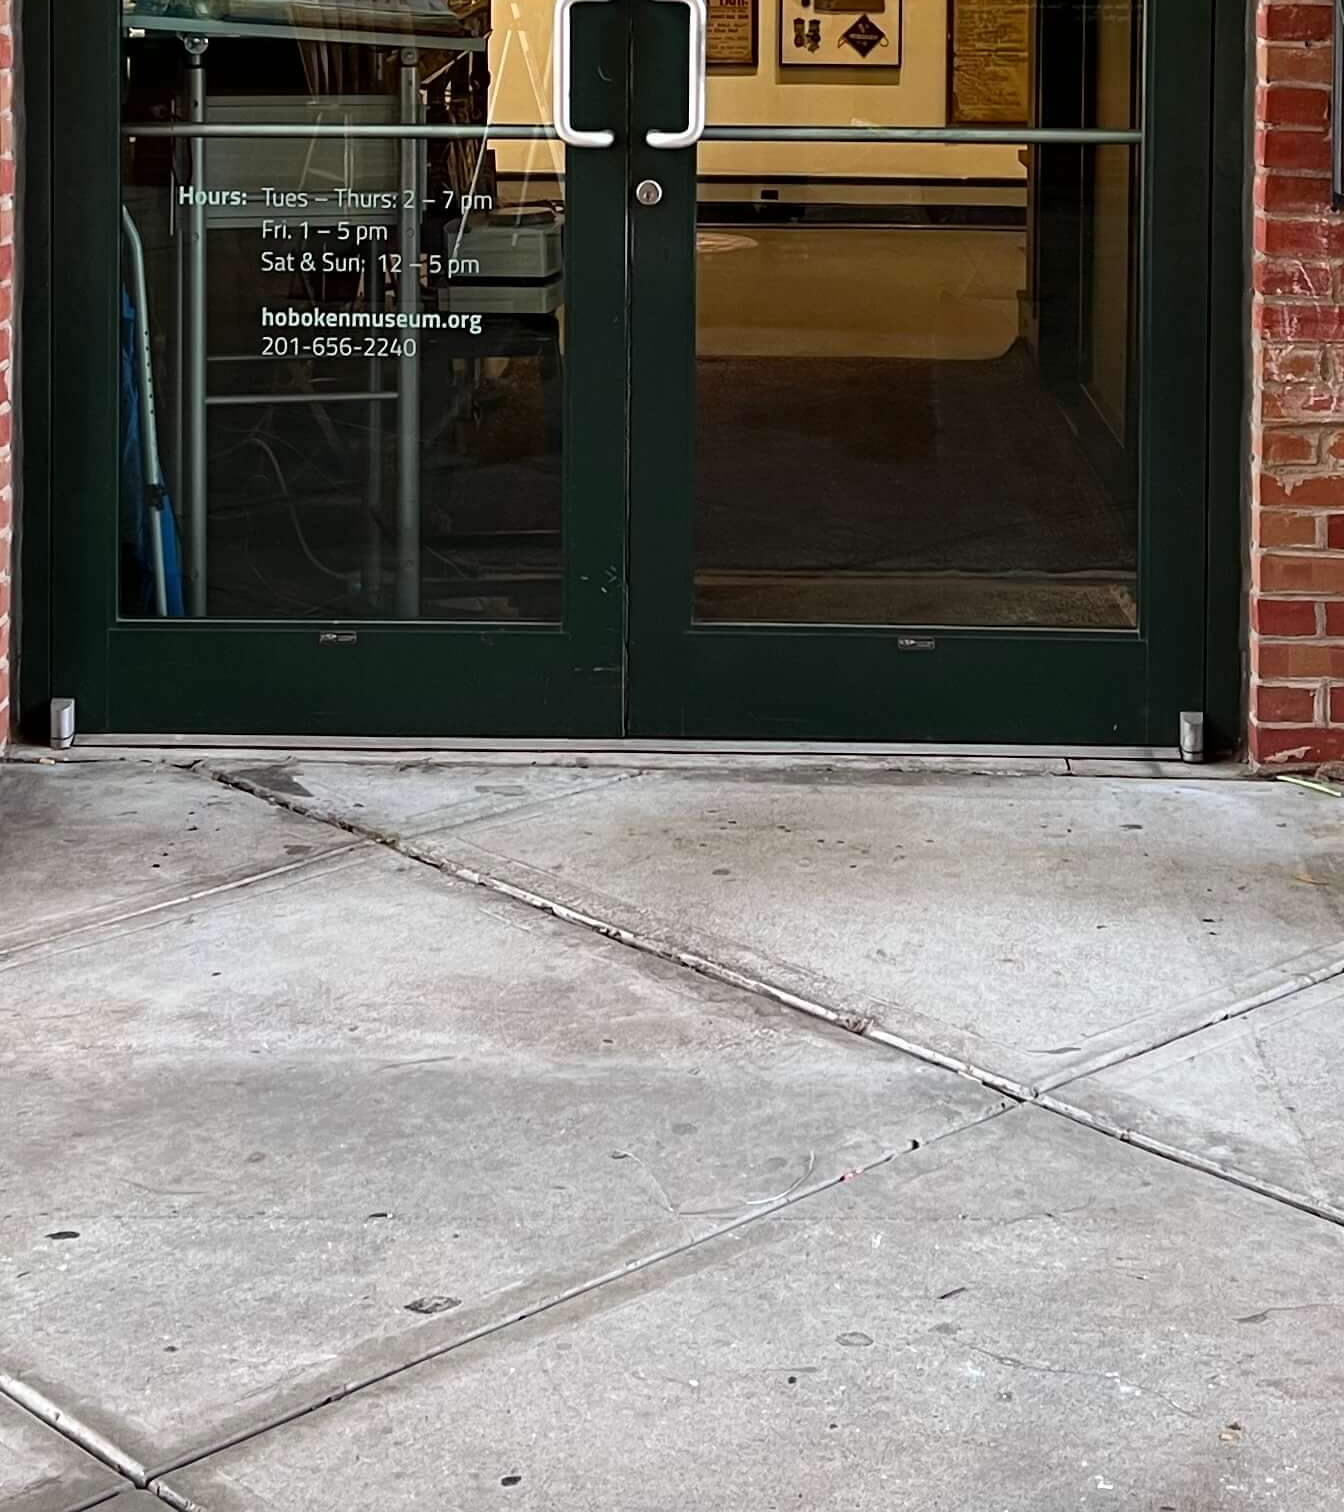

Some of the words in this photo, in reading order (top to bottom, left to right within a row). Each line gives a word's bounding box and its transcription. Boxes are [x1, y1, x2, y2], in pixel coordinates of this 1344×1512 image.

[178, 185, 248, 206] Hours:
[261, 187, 309, 208] Tues
[333, 188, 397, 209] Thurs:
[402, 190, 416, 209] 2
[442, 191, 454, 209] 7
[460, 194, 493, 215] pm
[261, 219, 293, 240] Fri.
[299, 221, 309, 240] 1
[336, 221, 350, 240] 5
[356, 225, 388, 246] pm
[260, 252, 296, 272] Sat
[300, 252, 317, 272] &
[321, 253, 366, 273] Sun:
[376, 254, 403, 273] 12
[429, 255, 442, 274] 5
[448, 257, 481, 278] pm
[260, 306, 483, 334] hobokenmuseum.org
[260, 336, 417, 357] 201-656-2240
